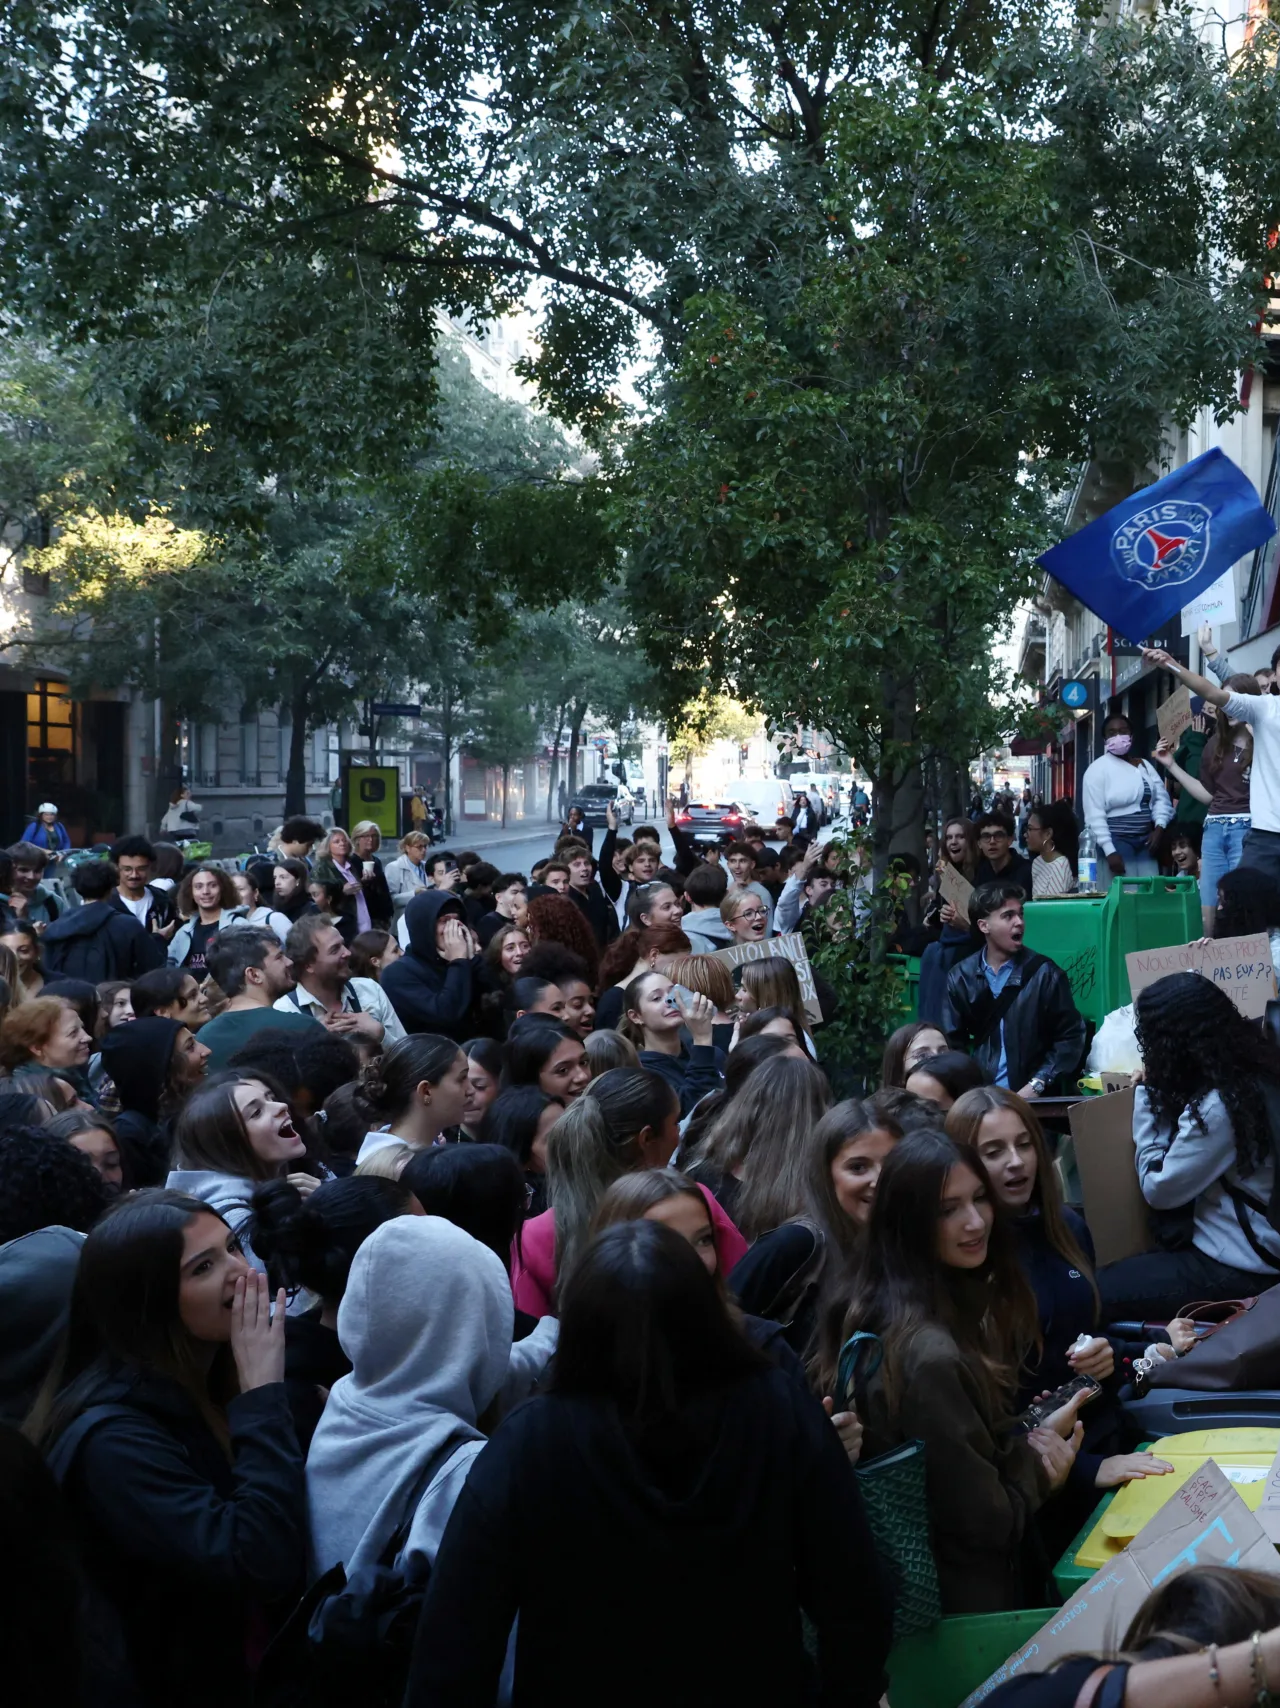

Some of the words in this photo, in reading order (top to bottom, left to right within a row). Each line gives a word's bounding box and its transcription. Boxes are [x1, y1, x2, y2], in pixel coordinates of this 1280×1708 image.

[1115, 505, 1178, 550] PARIS
[1067, 686, 1079, 702] 4
[1136, 954, 1174, 973] NOUS
[1178, 951, 1195, 969] ON
[1202, 947, 1213, 963] A
[1214, 944, 1233, 961] DES
[1235, 937, 1268, 958] PROFS
[1213, 967, 1232, 982] PAS
[1196, 1475, 1218, 1501] CACA
